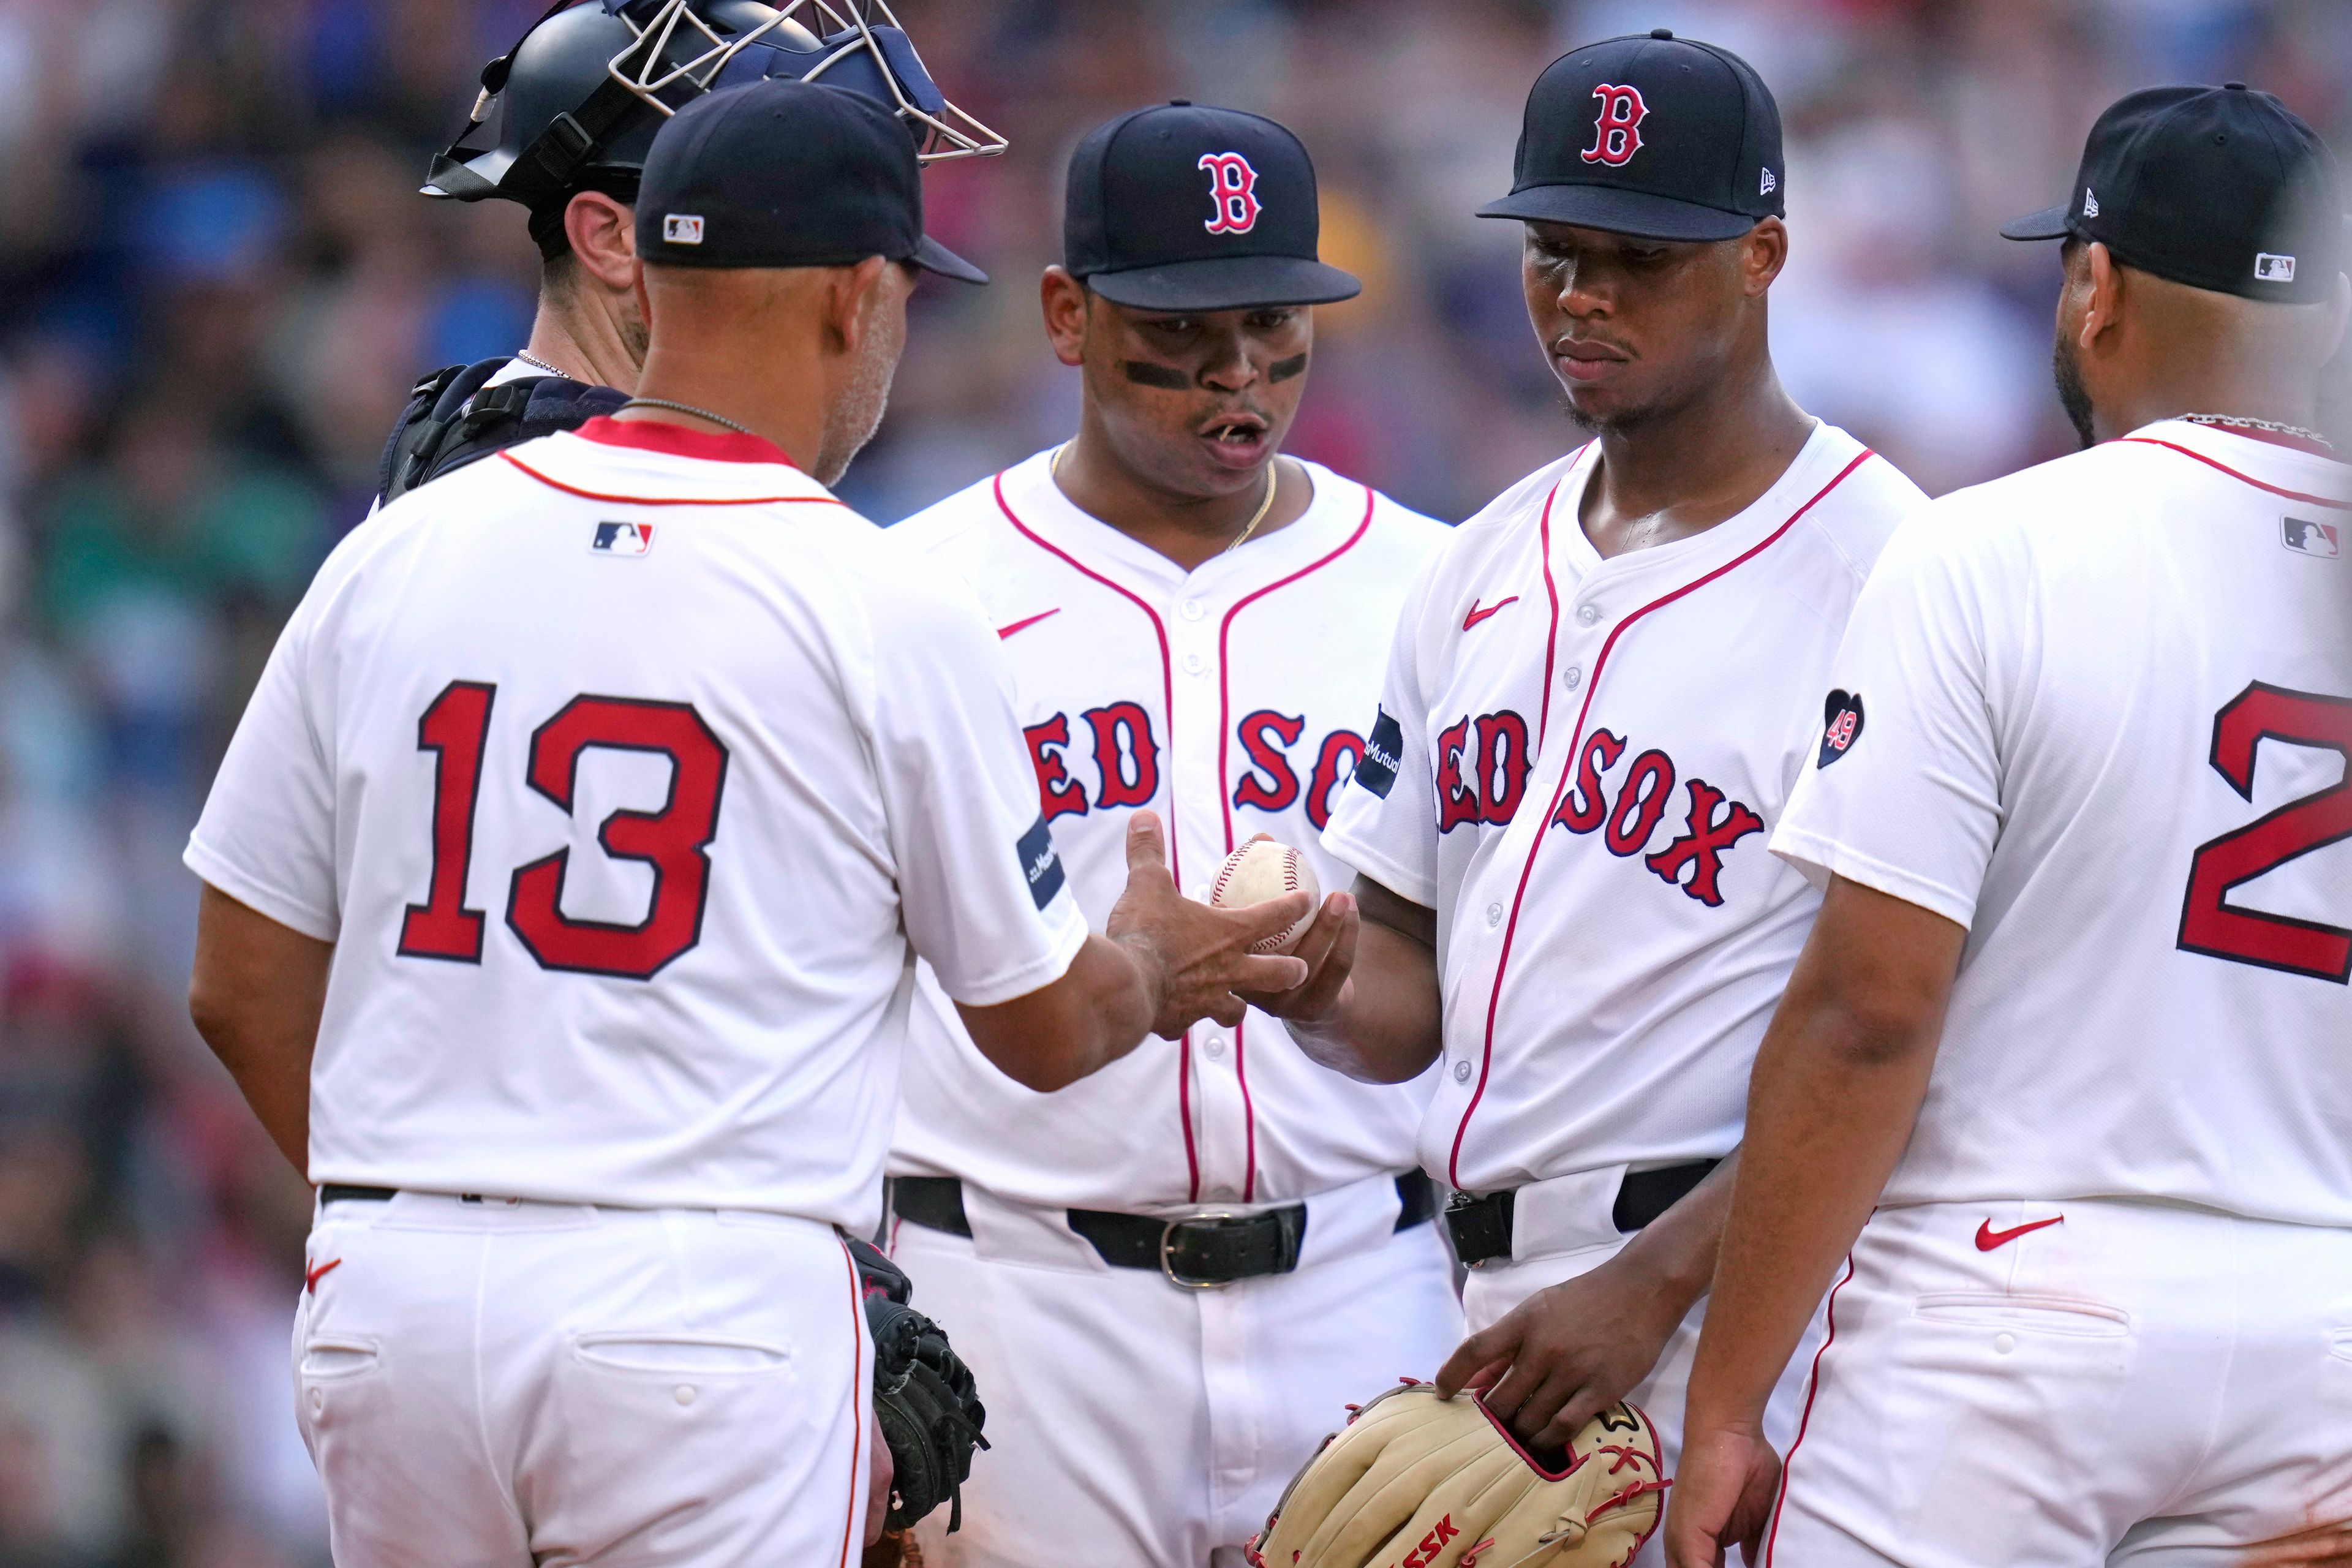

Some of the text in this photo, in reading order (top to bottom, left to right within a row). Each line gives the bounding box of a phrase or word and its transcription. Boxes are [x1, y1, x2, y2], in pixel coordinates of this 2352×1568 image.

[1581, 83, 1650, 167] B
[1197, 151, 1263, 235] B
[1022, 701, 1368, 832] ED SO
[1364, 740, 1401, 774] sMutual
[1826, 708, 1857, 751] 49
[396, 679, 729, 982] 13
[1436, 709, 1765, 907] ED SOX
[2176, 679, 2352, 986] 2
